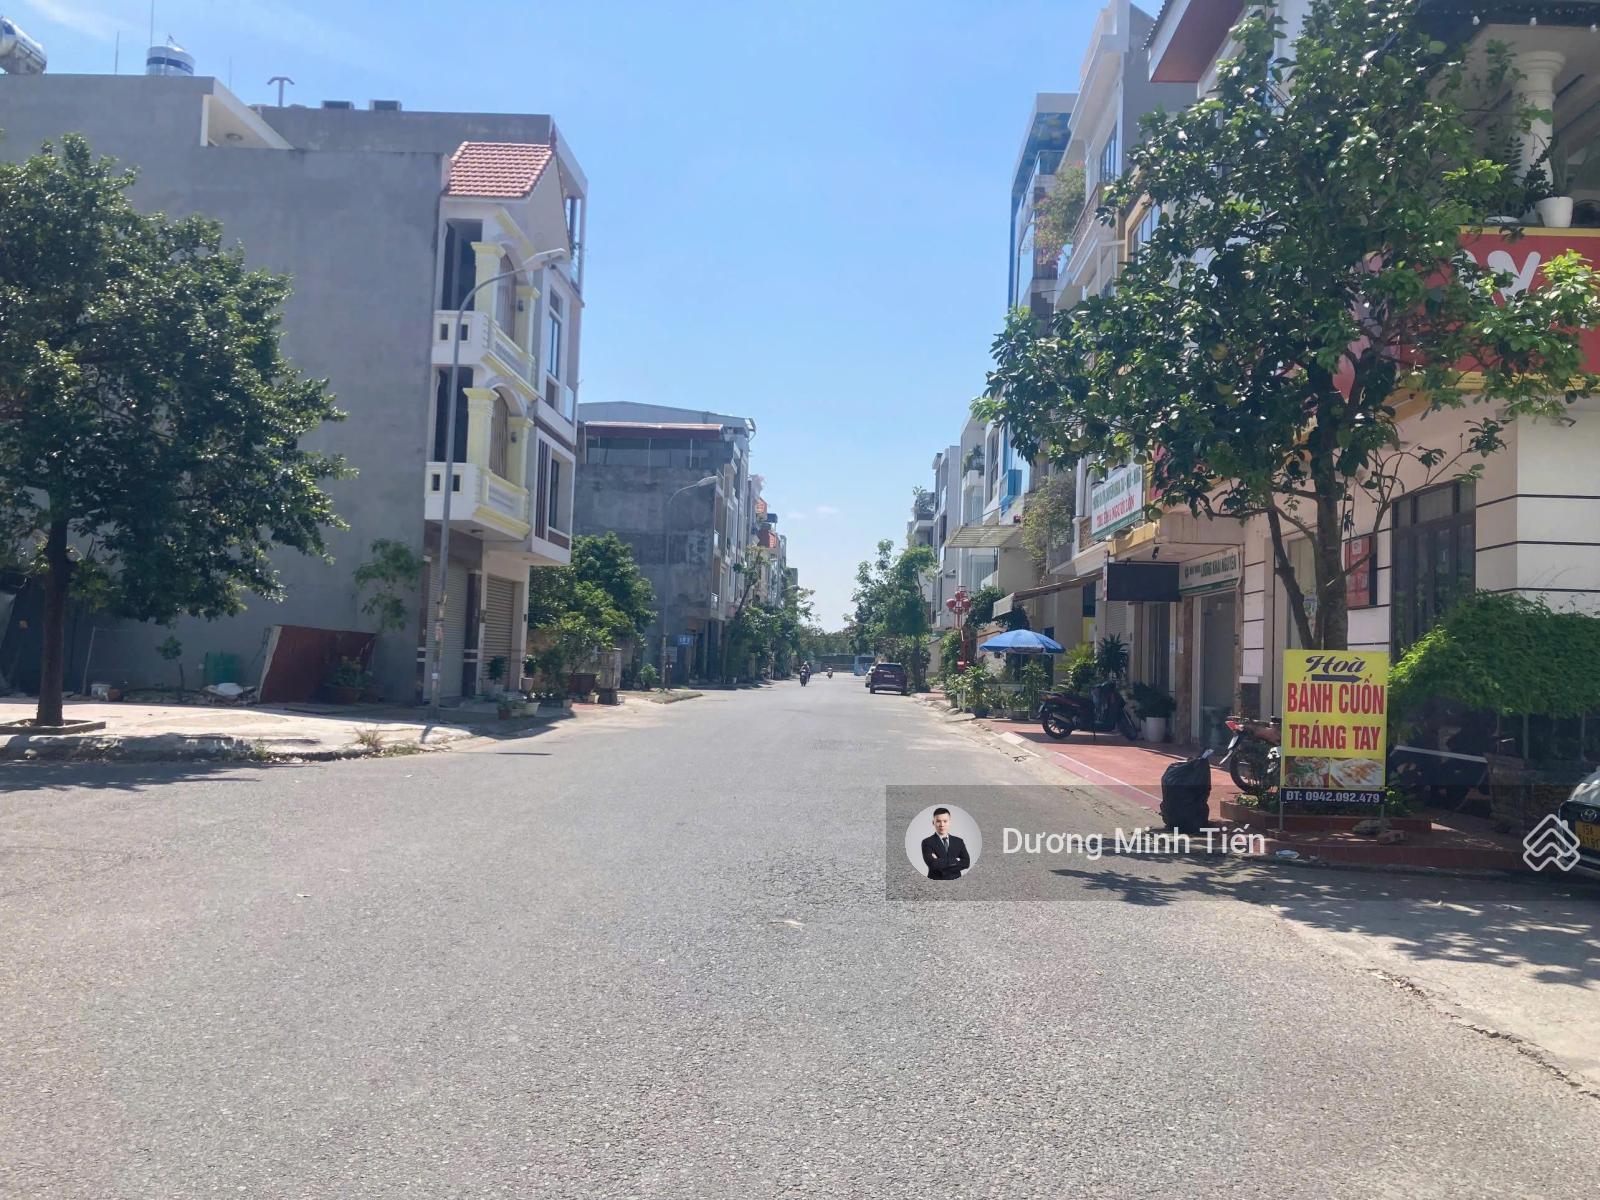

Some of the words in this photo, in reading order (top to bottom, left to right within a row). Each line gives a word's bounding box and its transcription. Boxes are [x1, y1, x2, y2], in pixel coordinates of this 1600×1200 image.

[1305, 655, 1366, 674] Hoà
[1287, 676, 1333, 713] BÁNH
[1338, 674, 1384, 715] CUỐN
[1289, 720, 1347, 750] TRÁNG
[1352, 726, 1381, 751] TAY
[1305, 791, 1380, 803] 0942.092.479
